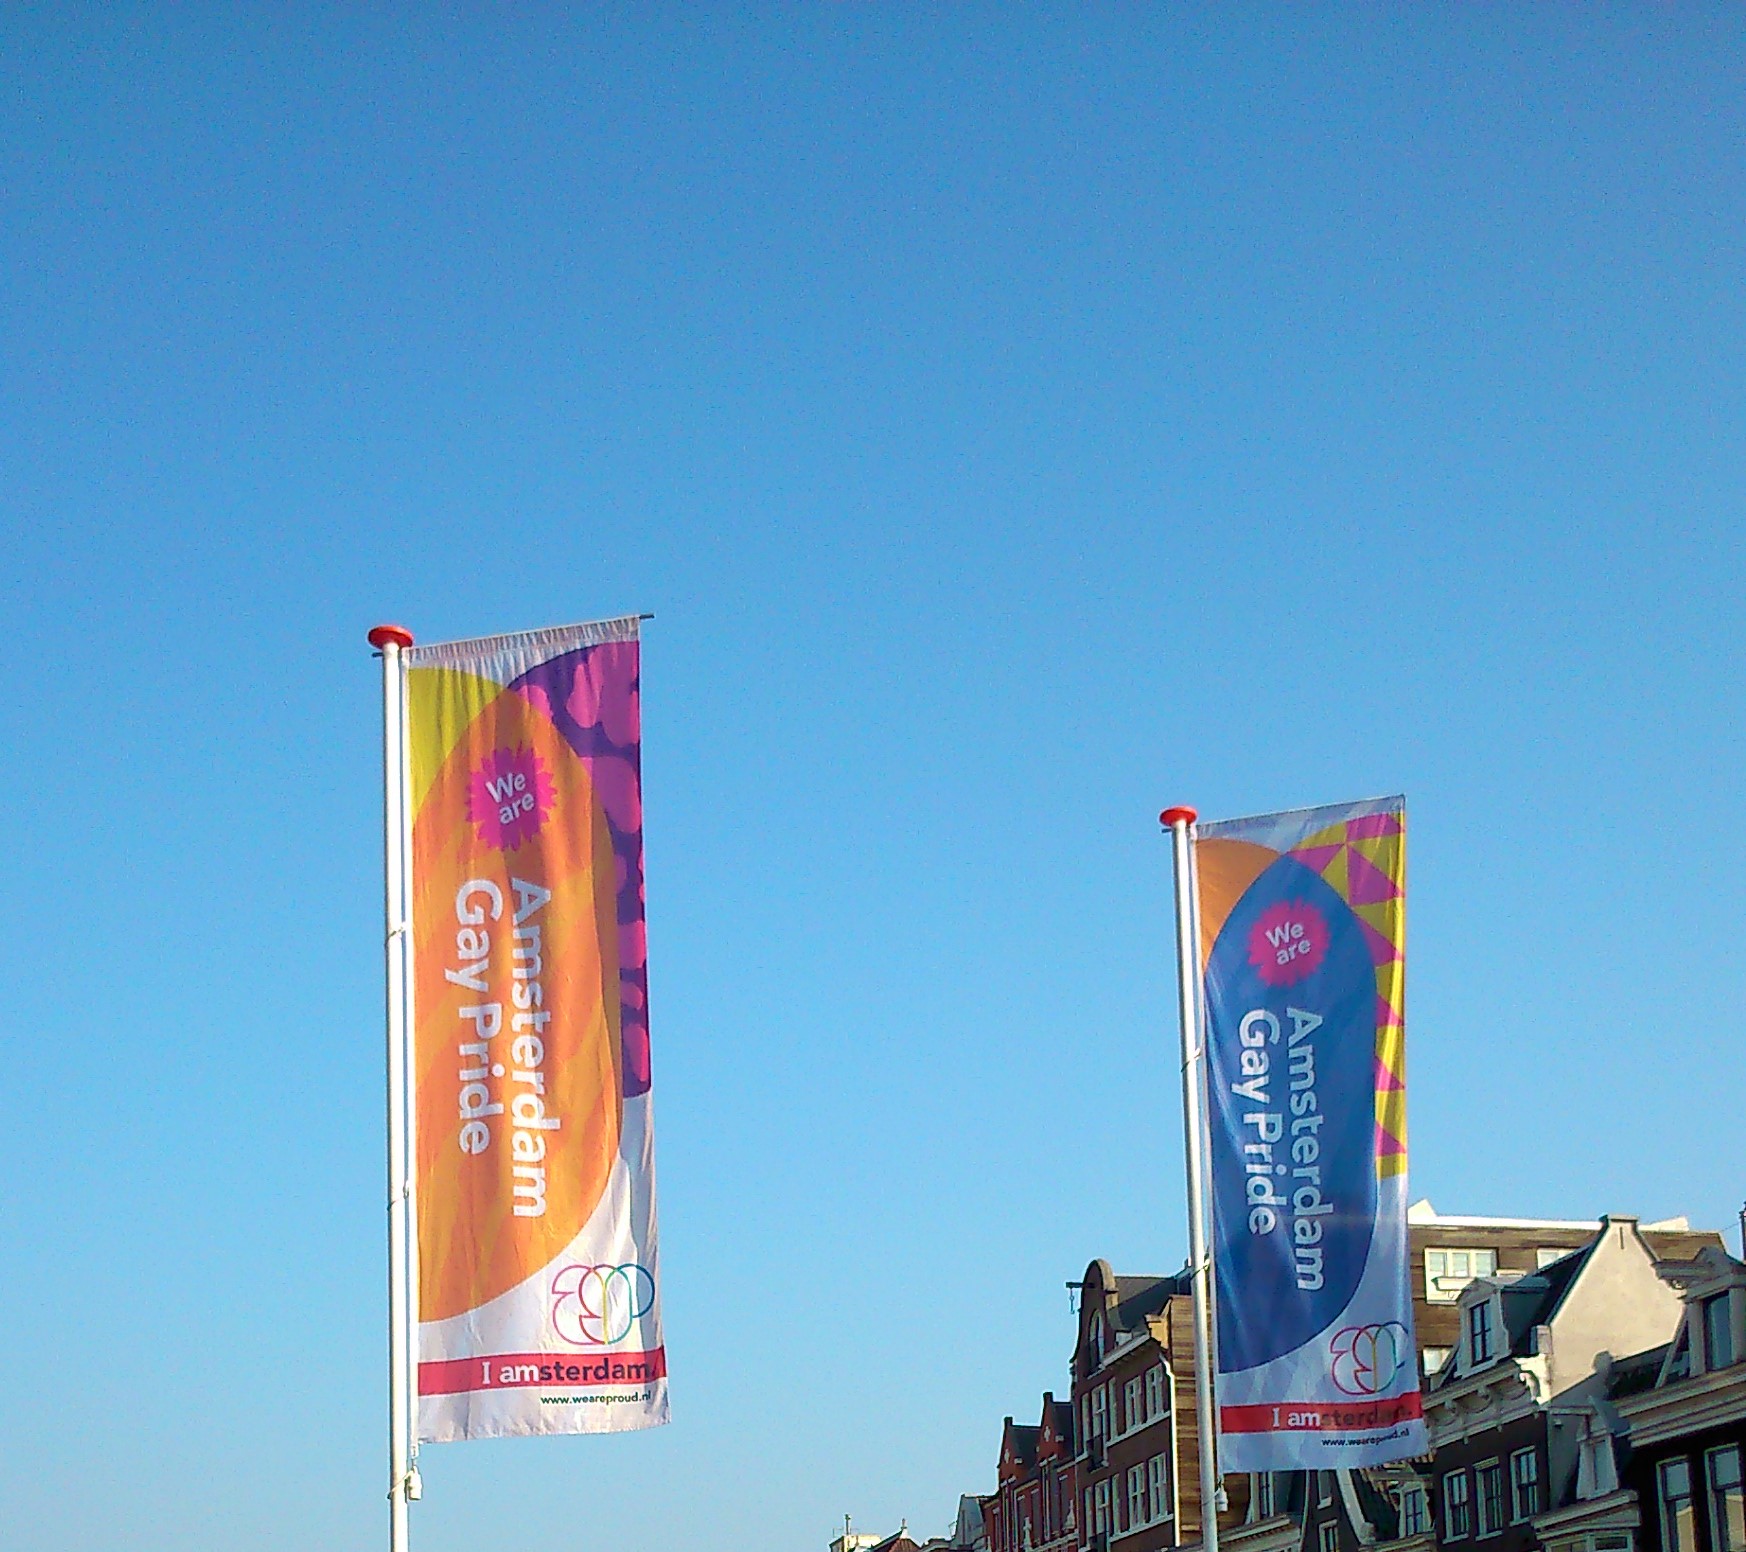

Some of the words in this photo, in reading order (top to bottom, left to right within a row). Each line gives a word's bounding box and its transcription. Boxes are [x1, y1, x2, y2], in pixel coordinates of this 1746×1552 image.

[486, 773, 526, 802] We
[499, 792, 535, 824] are
[445, 879, 504, 992] Gay
[1265, 921, 1304, 948] We
[1276, 940, 1311, 966] are
[511, 878, 561, 1217] Amsterdam
[1231, 1009, 1280, 1104] Gay
[458, 1002, 505, 1154] Pride
[1286, 1007, 1333, 1291] Amsterdam
[1243, 1113, 1287, 1235] Pride
[482, 1361, 491, 1385] I
[541, 1391, 651, 1405] www.weareproud.nl
[1272, 1408, 1280, 1427] I
[1321, 1428, 1410, 1445] www.wearepd.nl
